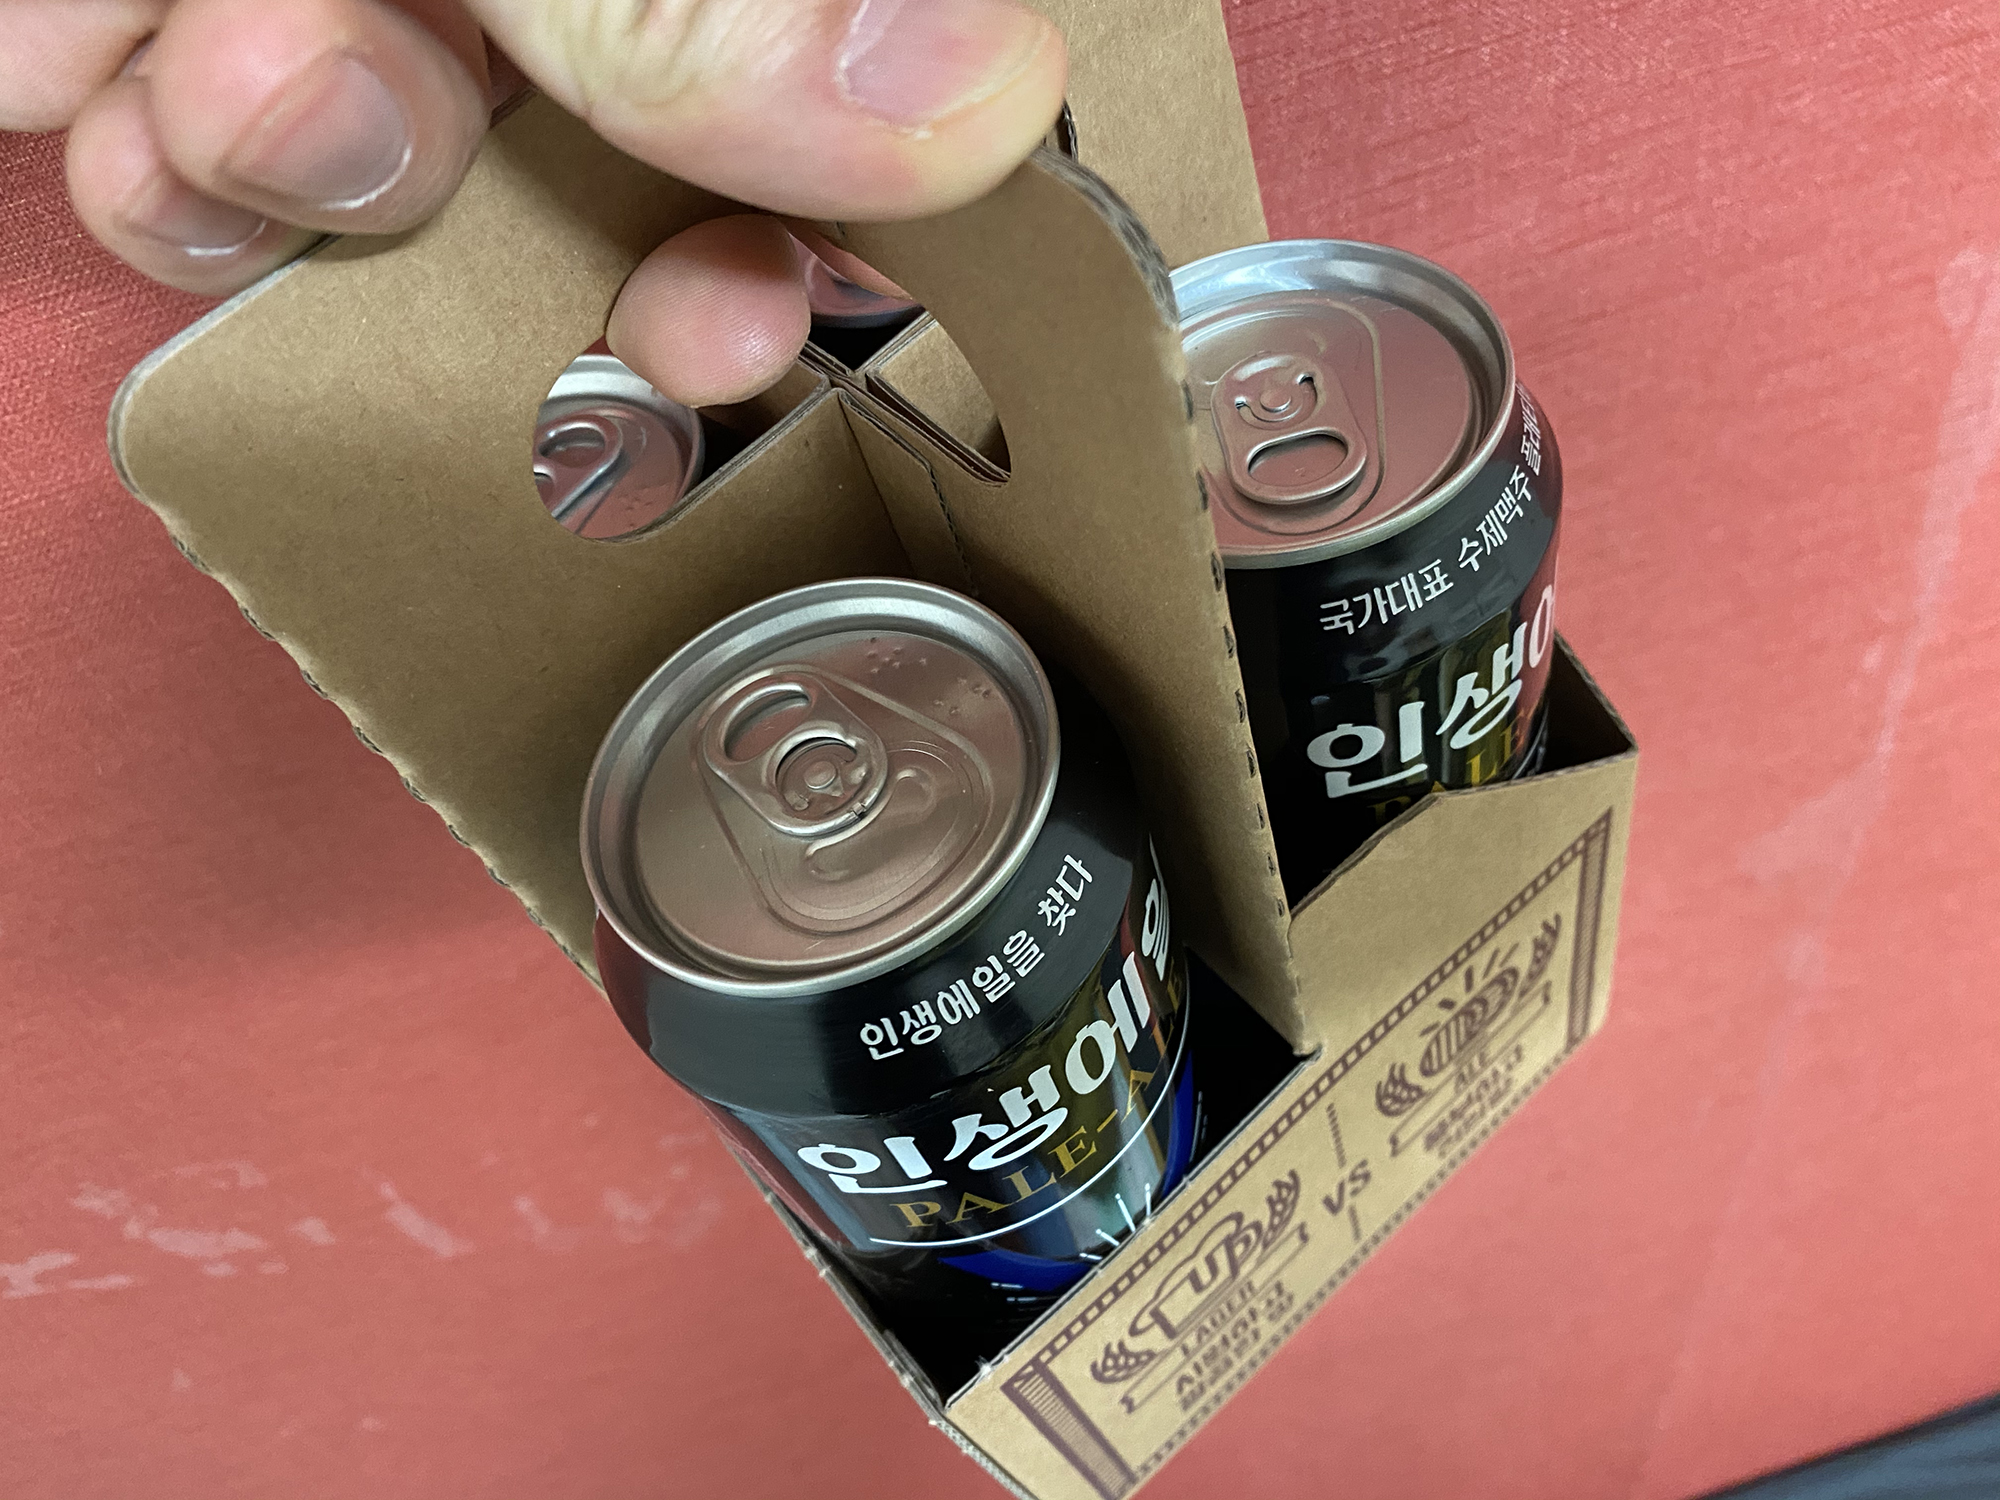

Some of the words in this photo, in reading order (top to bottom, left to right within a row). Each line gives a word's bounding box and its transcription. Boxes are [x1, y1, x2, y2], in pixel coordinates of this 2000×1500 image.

[1319, 558, 1454, 634] 국가대표
[1457, 464, 1533, 573] 수제맥주
[797, 834, 1171, 1194] 인생에일
[860, 929, 1045, 1061] 인생에일을
[1037, 854, 1094, 937] 찾다
[1321, 1159, 1373, 1217] VS
